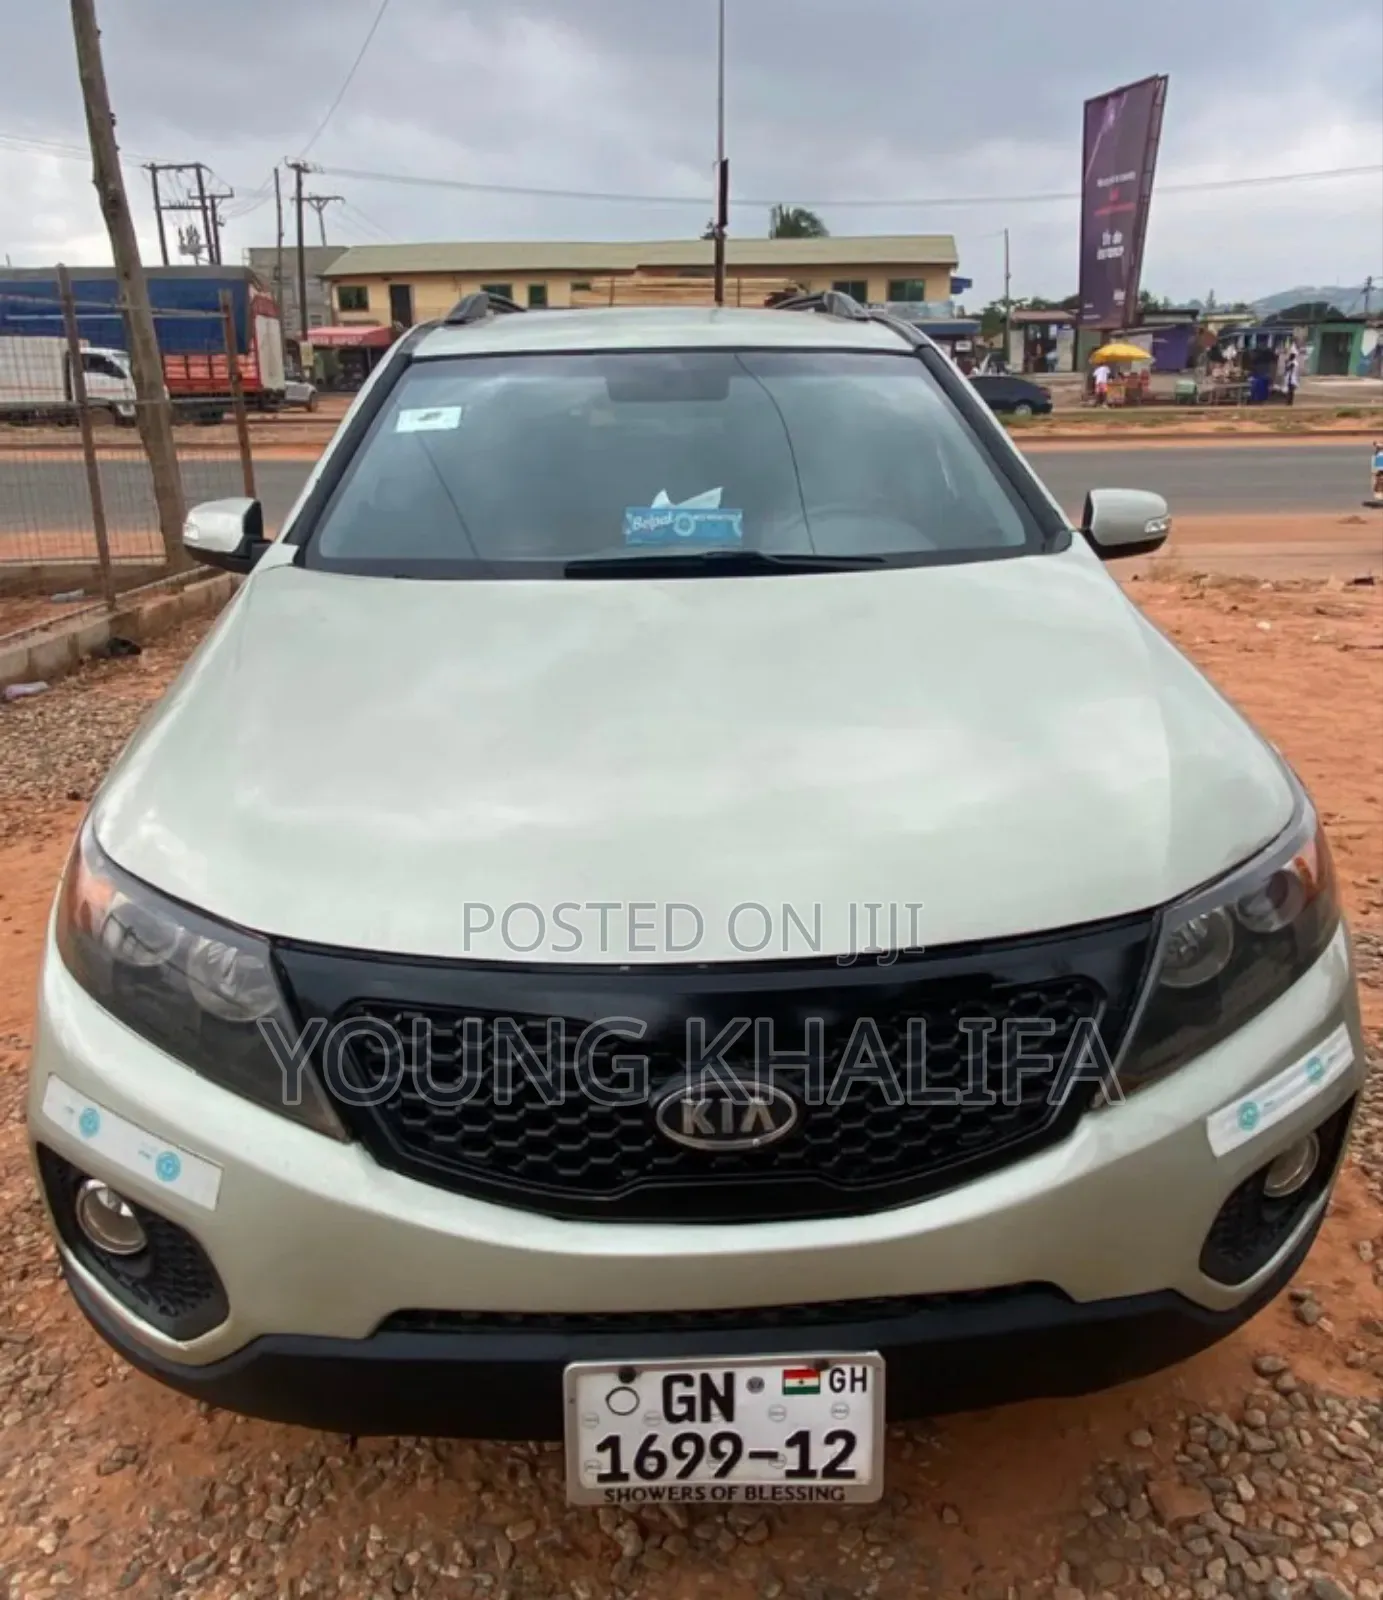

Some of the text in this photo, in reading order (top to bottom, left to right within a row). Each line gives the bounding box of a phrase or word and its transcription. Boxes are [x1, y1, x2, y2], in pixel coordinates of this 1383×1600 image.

[680, 1097, 776, 1135] KIA
[661, 1371, 735, 1424] GN
[828, 1367, 867, 1393] GH
[595, 1429, 857, 1482] 1699-12
[604, 1486, 845, 1503] SHOWERS OF BLESSING
